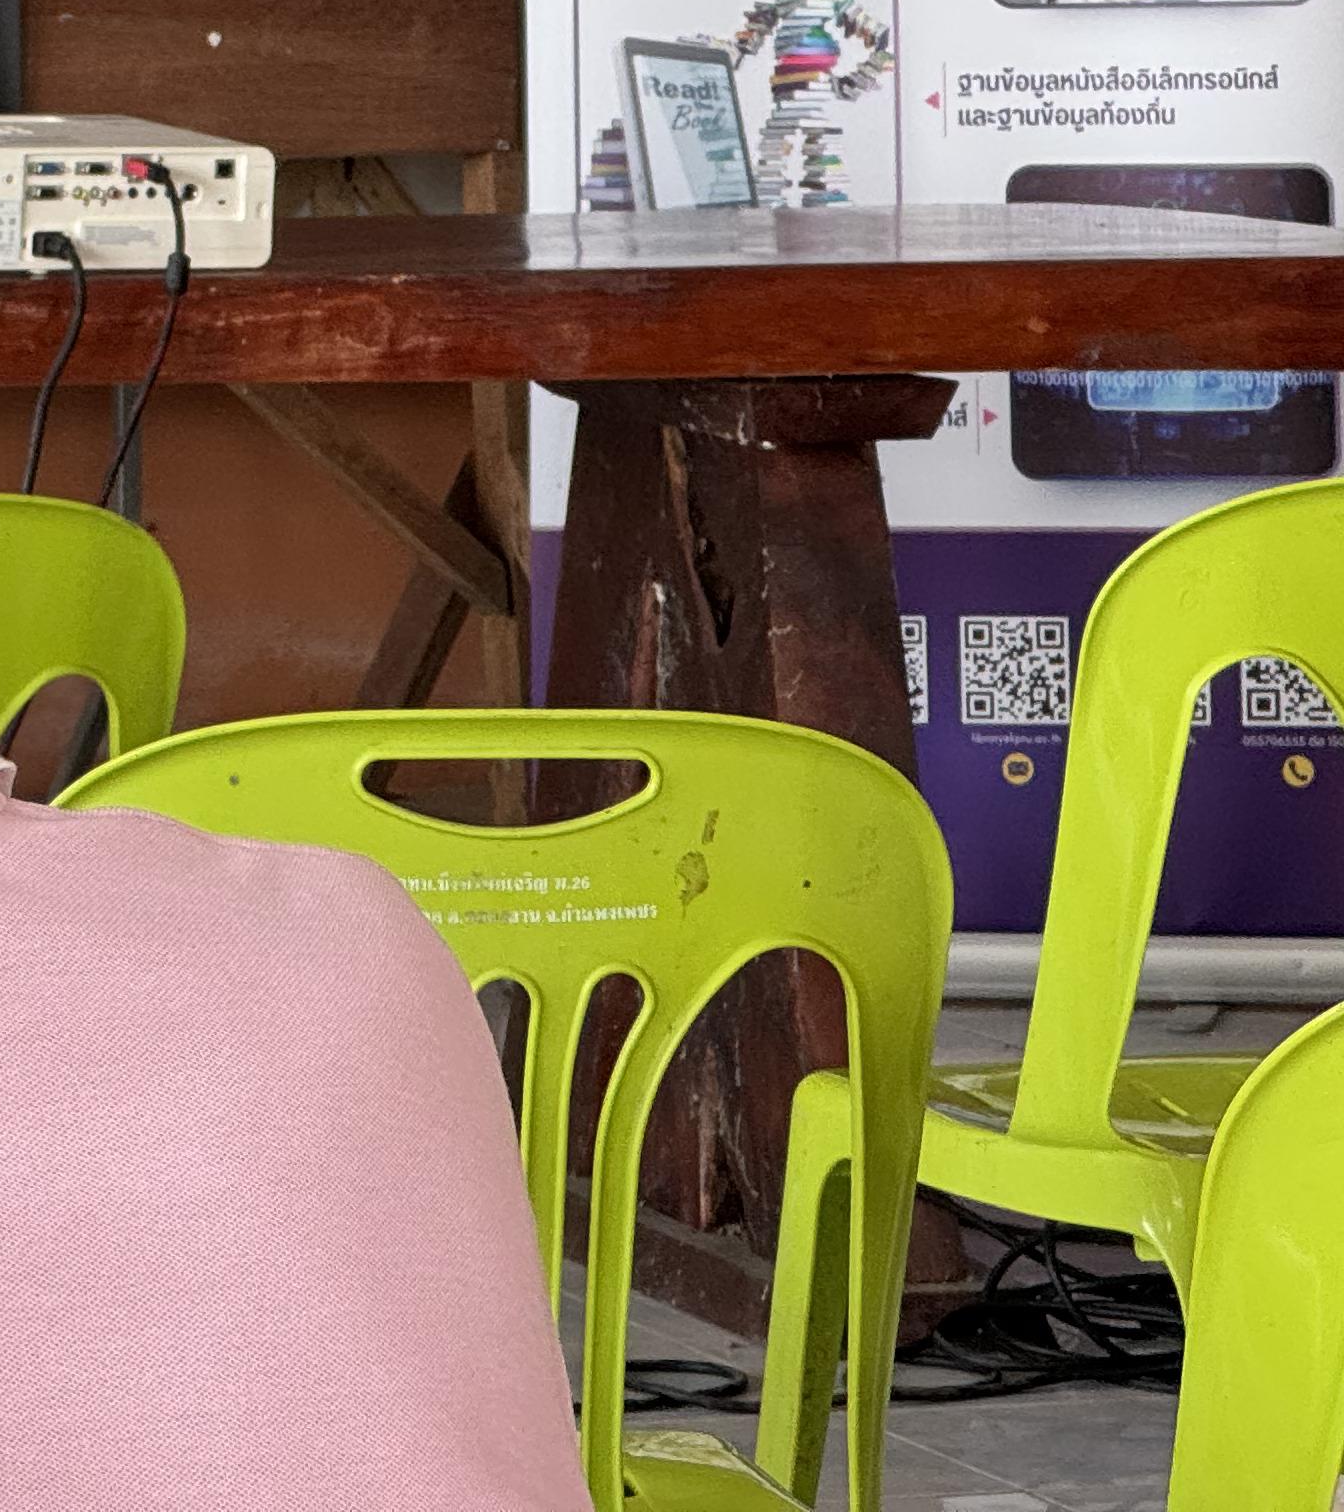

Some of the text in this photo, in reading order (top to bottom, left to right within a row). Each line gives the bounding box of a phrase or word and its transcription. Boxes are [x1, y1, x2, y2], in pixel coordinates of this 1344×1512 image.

[958, 65, 1280, 97] ฐานข้อมูลหนังสืออิเล็กทรอนิกส์
[958, 97, 1176, 132] และฐานข้อมูลท้องถิ่น
